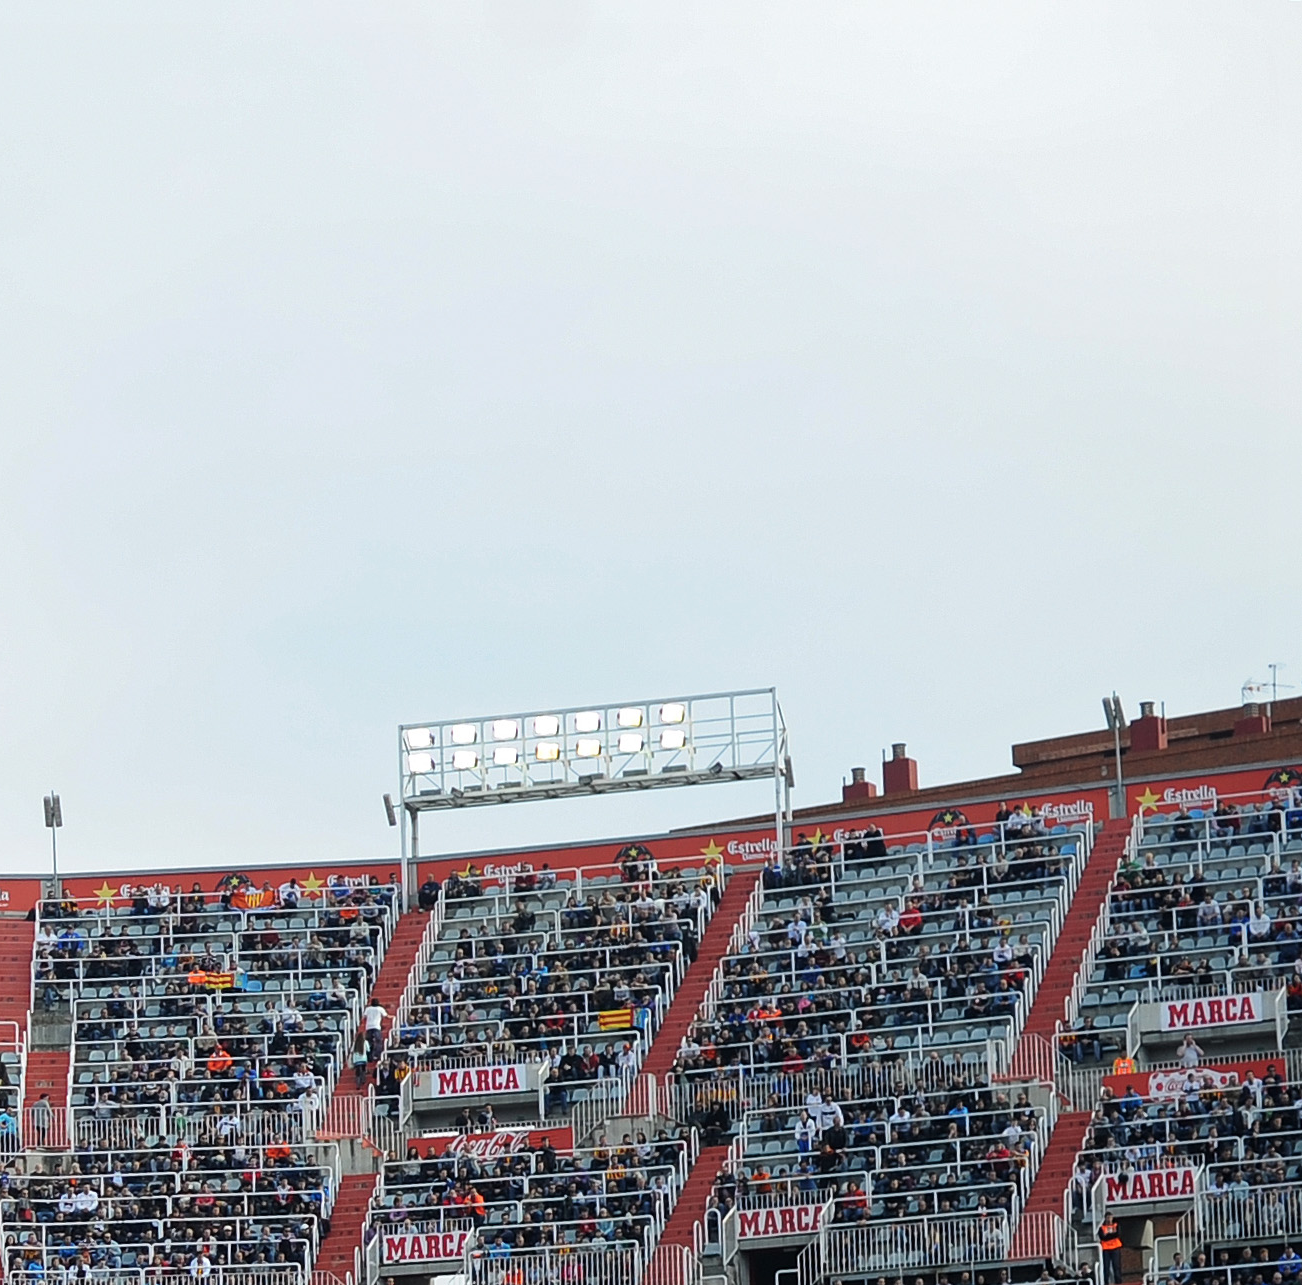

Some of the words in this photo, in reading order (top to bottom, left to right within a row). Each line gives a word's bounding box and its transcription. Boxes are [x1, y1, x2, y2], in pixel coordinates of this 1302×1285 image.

[1164, 786, 1216, 801] Estrella
[1042, 800, 1093, 819] Estrella
[726, 835, 777, 855] Estrella
[1168, 998, 1255, 1026] MARCA
[438, 1068, 519, 1094] MARCA
[1106, 1172, 1193, 1202] MARCA
